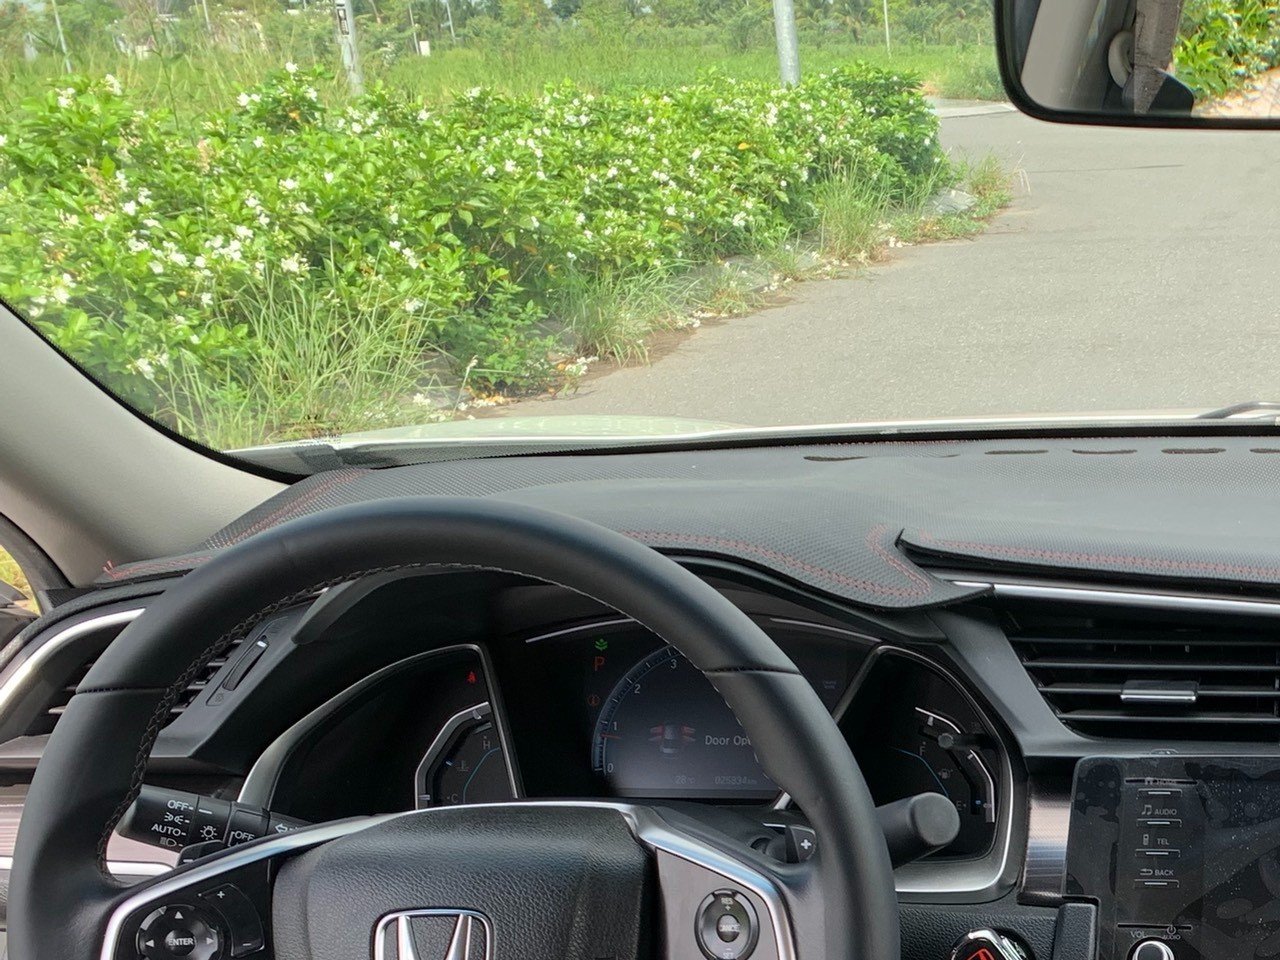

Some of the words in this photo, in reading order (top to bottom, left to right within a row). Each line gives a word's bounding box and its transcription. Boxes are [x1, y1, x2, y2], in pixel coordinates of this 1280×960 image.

[593, 656, 605, 672] P
[670, 659, 677, 669] 3
[634, 684, 641, 694] 2
[705, 735, 730, 745] Door
[167, 799, 189, 812] OFF
[1154, 808, 1178, 817] AUDIO
[151, 823, 182, 838] AUTO
[1157, 838, 1170, 846] TEL
[1154, 868, 1174, 877] BACK
[168, 938, 195, 946] ENTER
